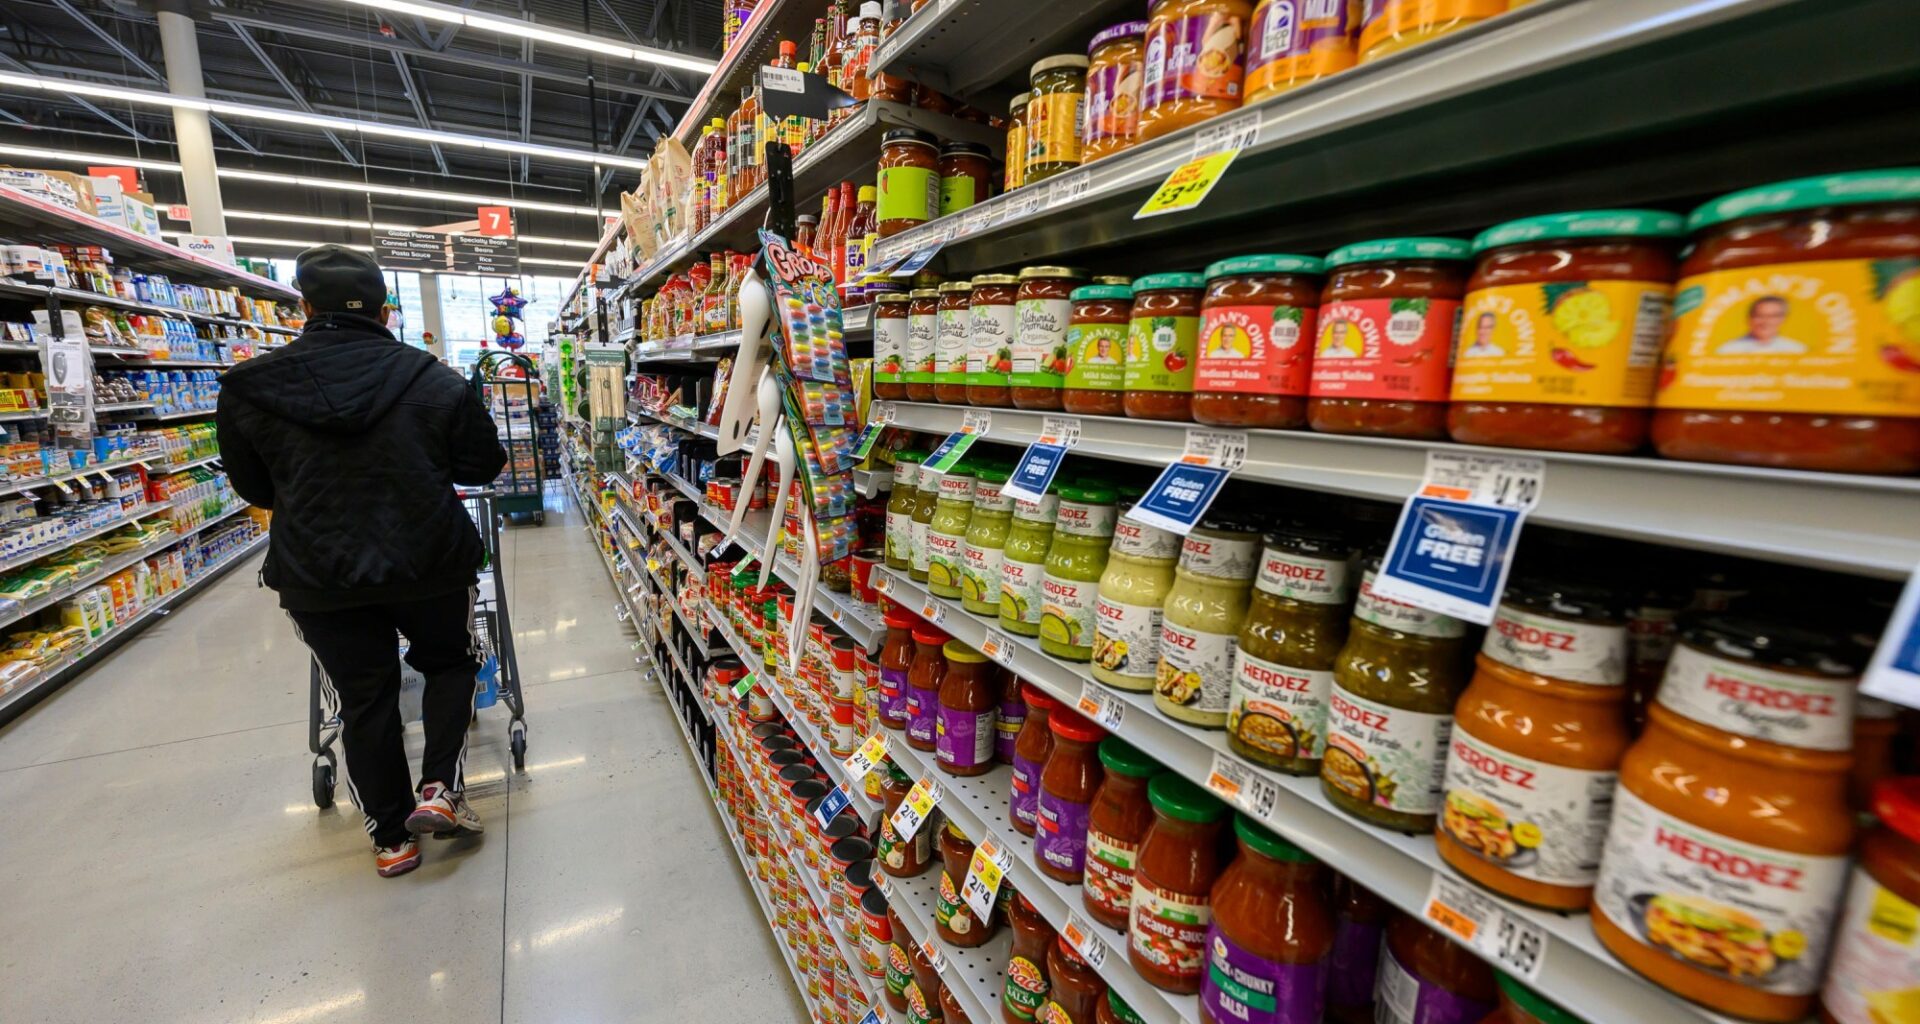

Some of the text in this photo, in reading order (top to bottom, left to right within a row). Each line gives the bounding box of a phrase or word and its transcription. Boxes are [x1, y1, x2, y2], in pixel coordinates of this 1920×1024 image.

[488, 212, 500, 230] 7
[388, 230, 435, 240] Global Flavors
[408, 241, 440, 250] Tomatoes
[460, 236, 507, 246] Specialty Beans
[411, 250, 431, 259] Sauce
[1021, 309, 1057, 324] Nature's
[1020, 321, 1062, 334] Promise
[1200, 311, 1266, 360] NEWMAN'S OWN
[1077, 327, 1121, 365] NEWMAN'S
[1024, 464, 1046, 477] FREE
[1030, 455, 1050, 467] Gluten
[975, 487, 1001, 498] ERDEZ
[1170, 476, 1205, 491] Gluten
[1162, 486, 1201, 503] FREE
[1058, 507, 1088, 520] ERDEZ
[1424, 523, 1486, 547] Gluten
[1415, 538, 1484, 567] FREE
[1266, 560, 1327, 582] HERDEZ
[1243, 661, 1311, 693] HERDEZ
[1263, 686, 1289, 702] Salsa
[1705, 672, 1837, 717] HERDEZ
[1339, 717, 1365, 737] Salsa
[900, 804, 920, 828] 2/$4
[1655, 826, 1805, 892] HERDEZ
[1088, 857, 1134, 887] icante sauc
[969, 873, 992, 906] 2/$4
[1008, 960, 1050, 994] Pace
[1234, 968, 1276, 996] CHUNKY
[1006, 984, 1036, 1007] SALSA
[1219, 991, 1250, 1022] SALSA
